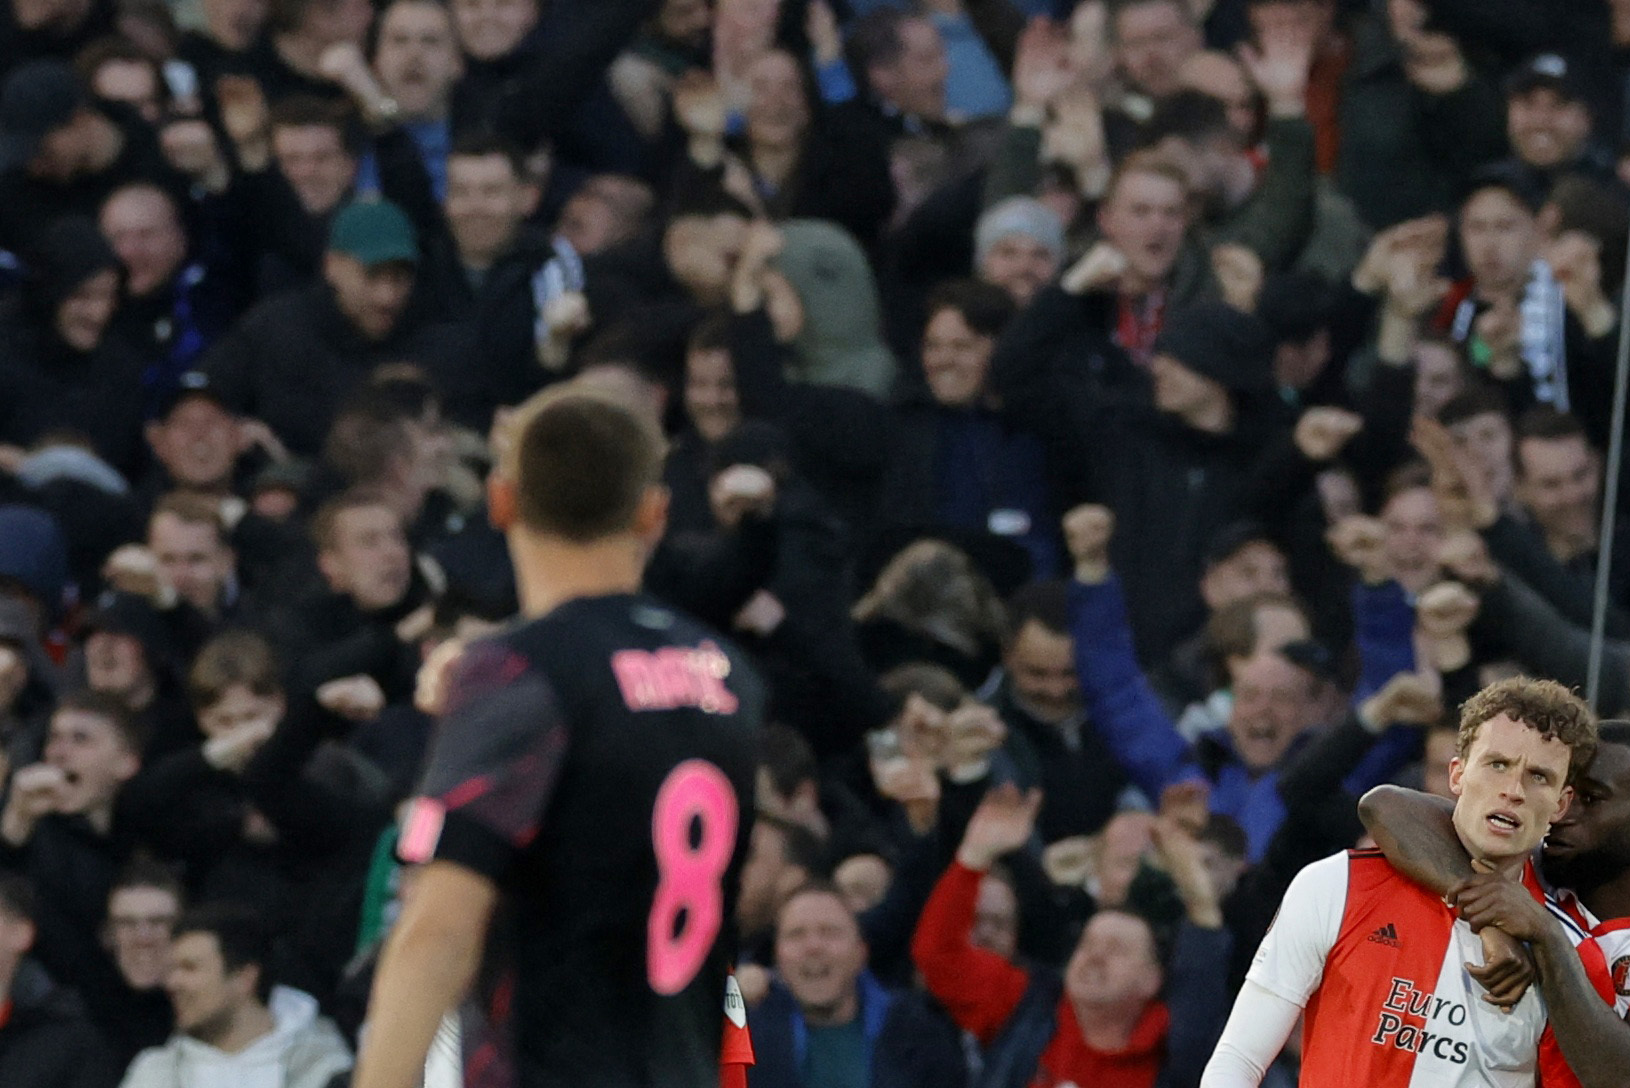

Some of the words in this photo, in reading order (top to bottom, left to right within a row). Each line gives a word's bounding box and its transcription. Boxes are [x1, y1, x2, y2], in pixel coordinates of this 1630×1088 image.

[647, 758, 740, 996] 8
[726, 992, 744, 1010] TOT
[1383, 976, 1467, 1026] Euro
[1371, 1011, 1468, 1064] Parcs
